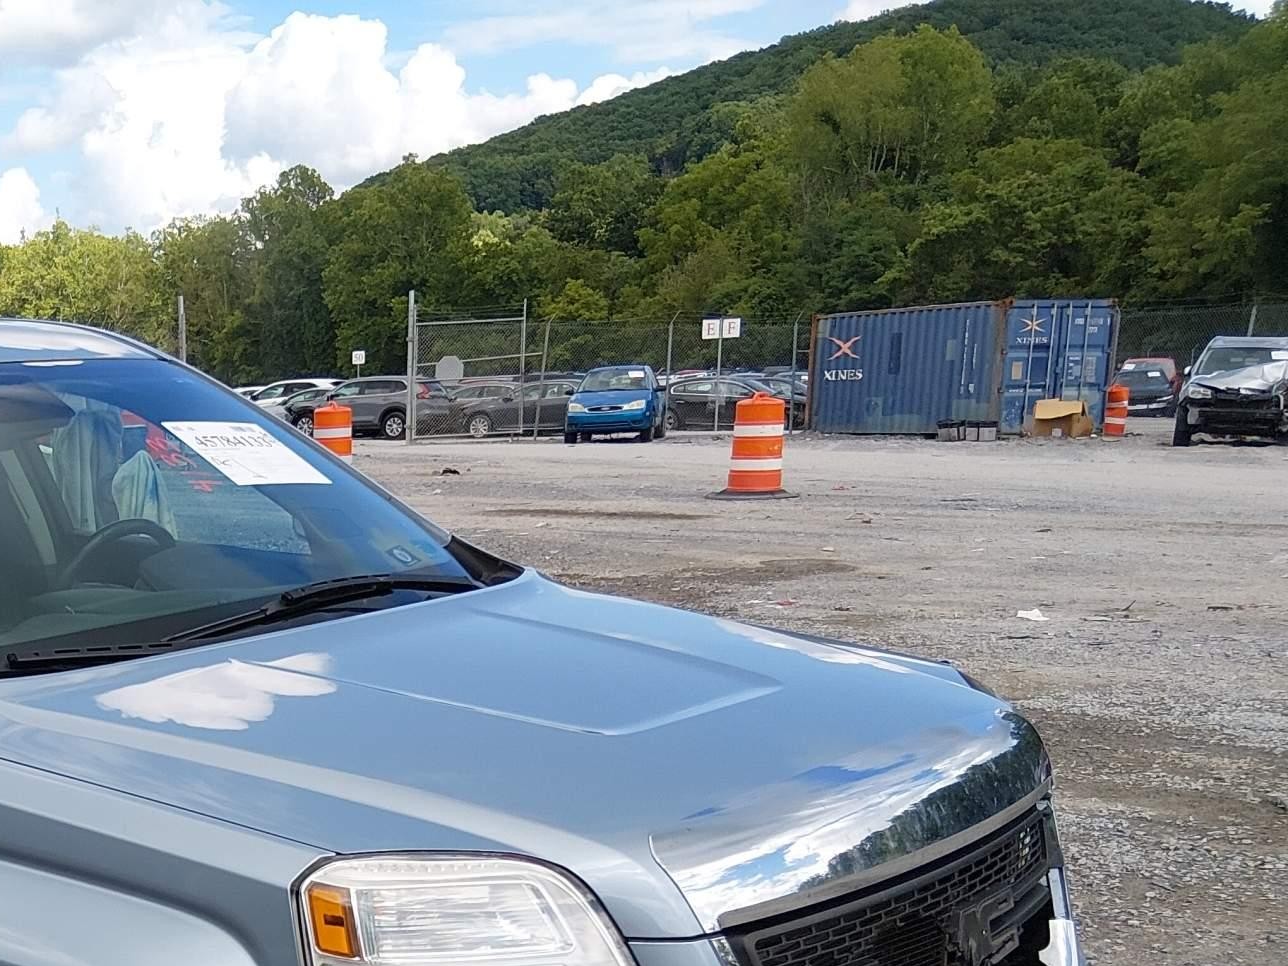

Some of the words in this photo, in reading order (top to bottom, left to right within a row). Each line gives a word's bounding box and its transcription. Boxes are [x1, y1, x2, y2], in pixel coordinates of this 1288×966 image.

[707, 322, 716, 336] E
[727, 321, 737, 335] F
[823, 368, 864, 381] XINES
